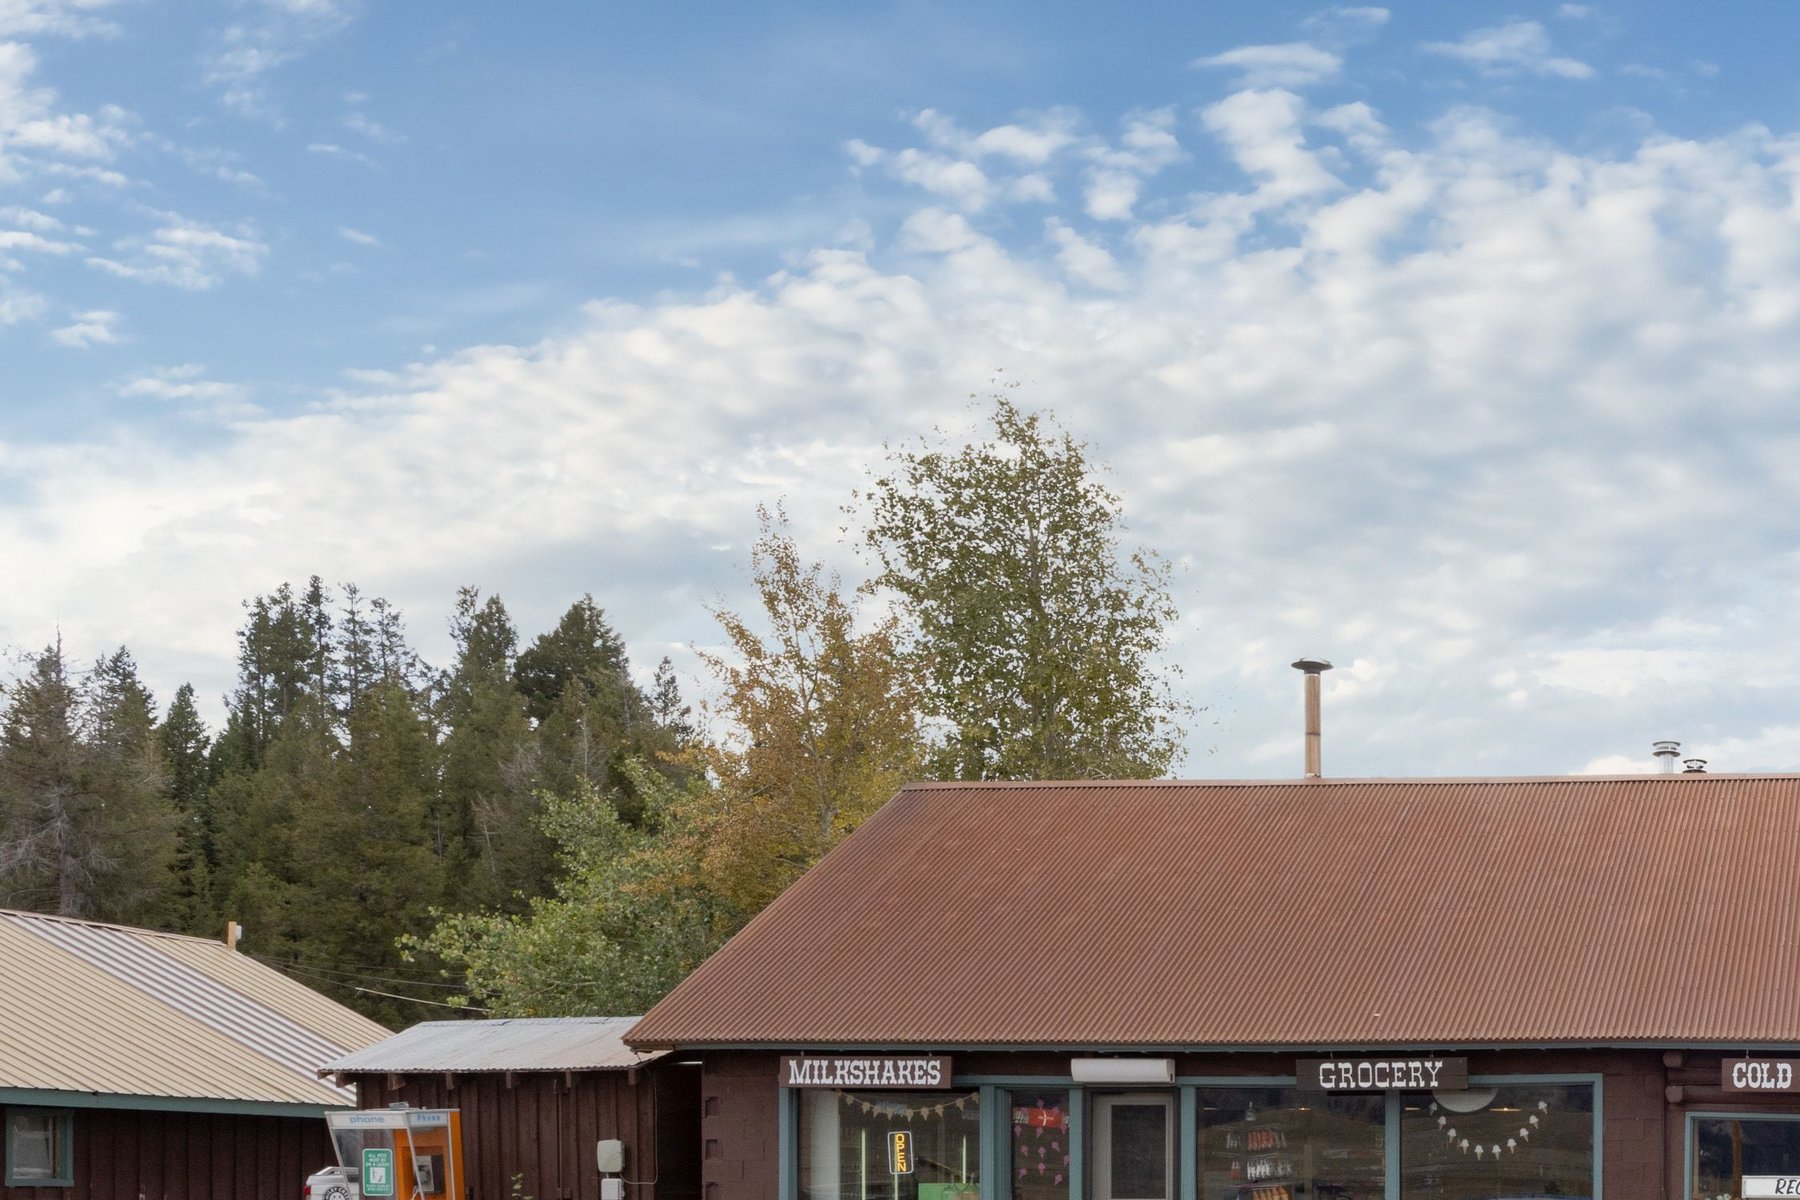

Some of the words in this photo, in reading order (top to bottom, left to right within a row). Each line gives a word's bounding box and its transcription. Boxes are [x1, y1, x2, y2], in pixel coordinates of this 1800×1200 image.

[789, 1059, 941, 1085] MILKSHAKES
[1319, 1061, 1443, 1088] GROCERY
[1732, 1062, 1792, 1089] COLD
[349, 1114, 385, 1123] phone
[895, 1133, 907, 1172] OPEN
